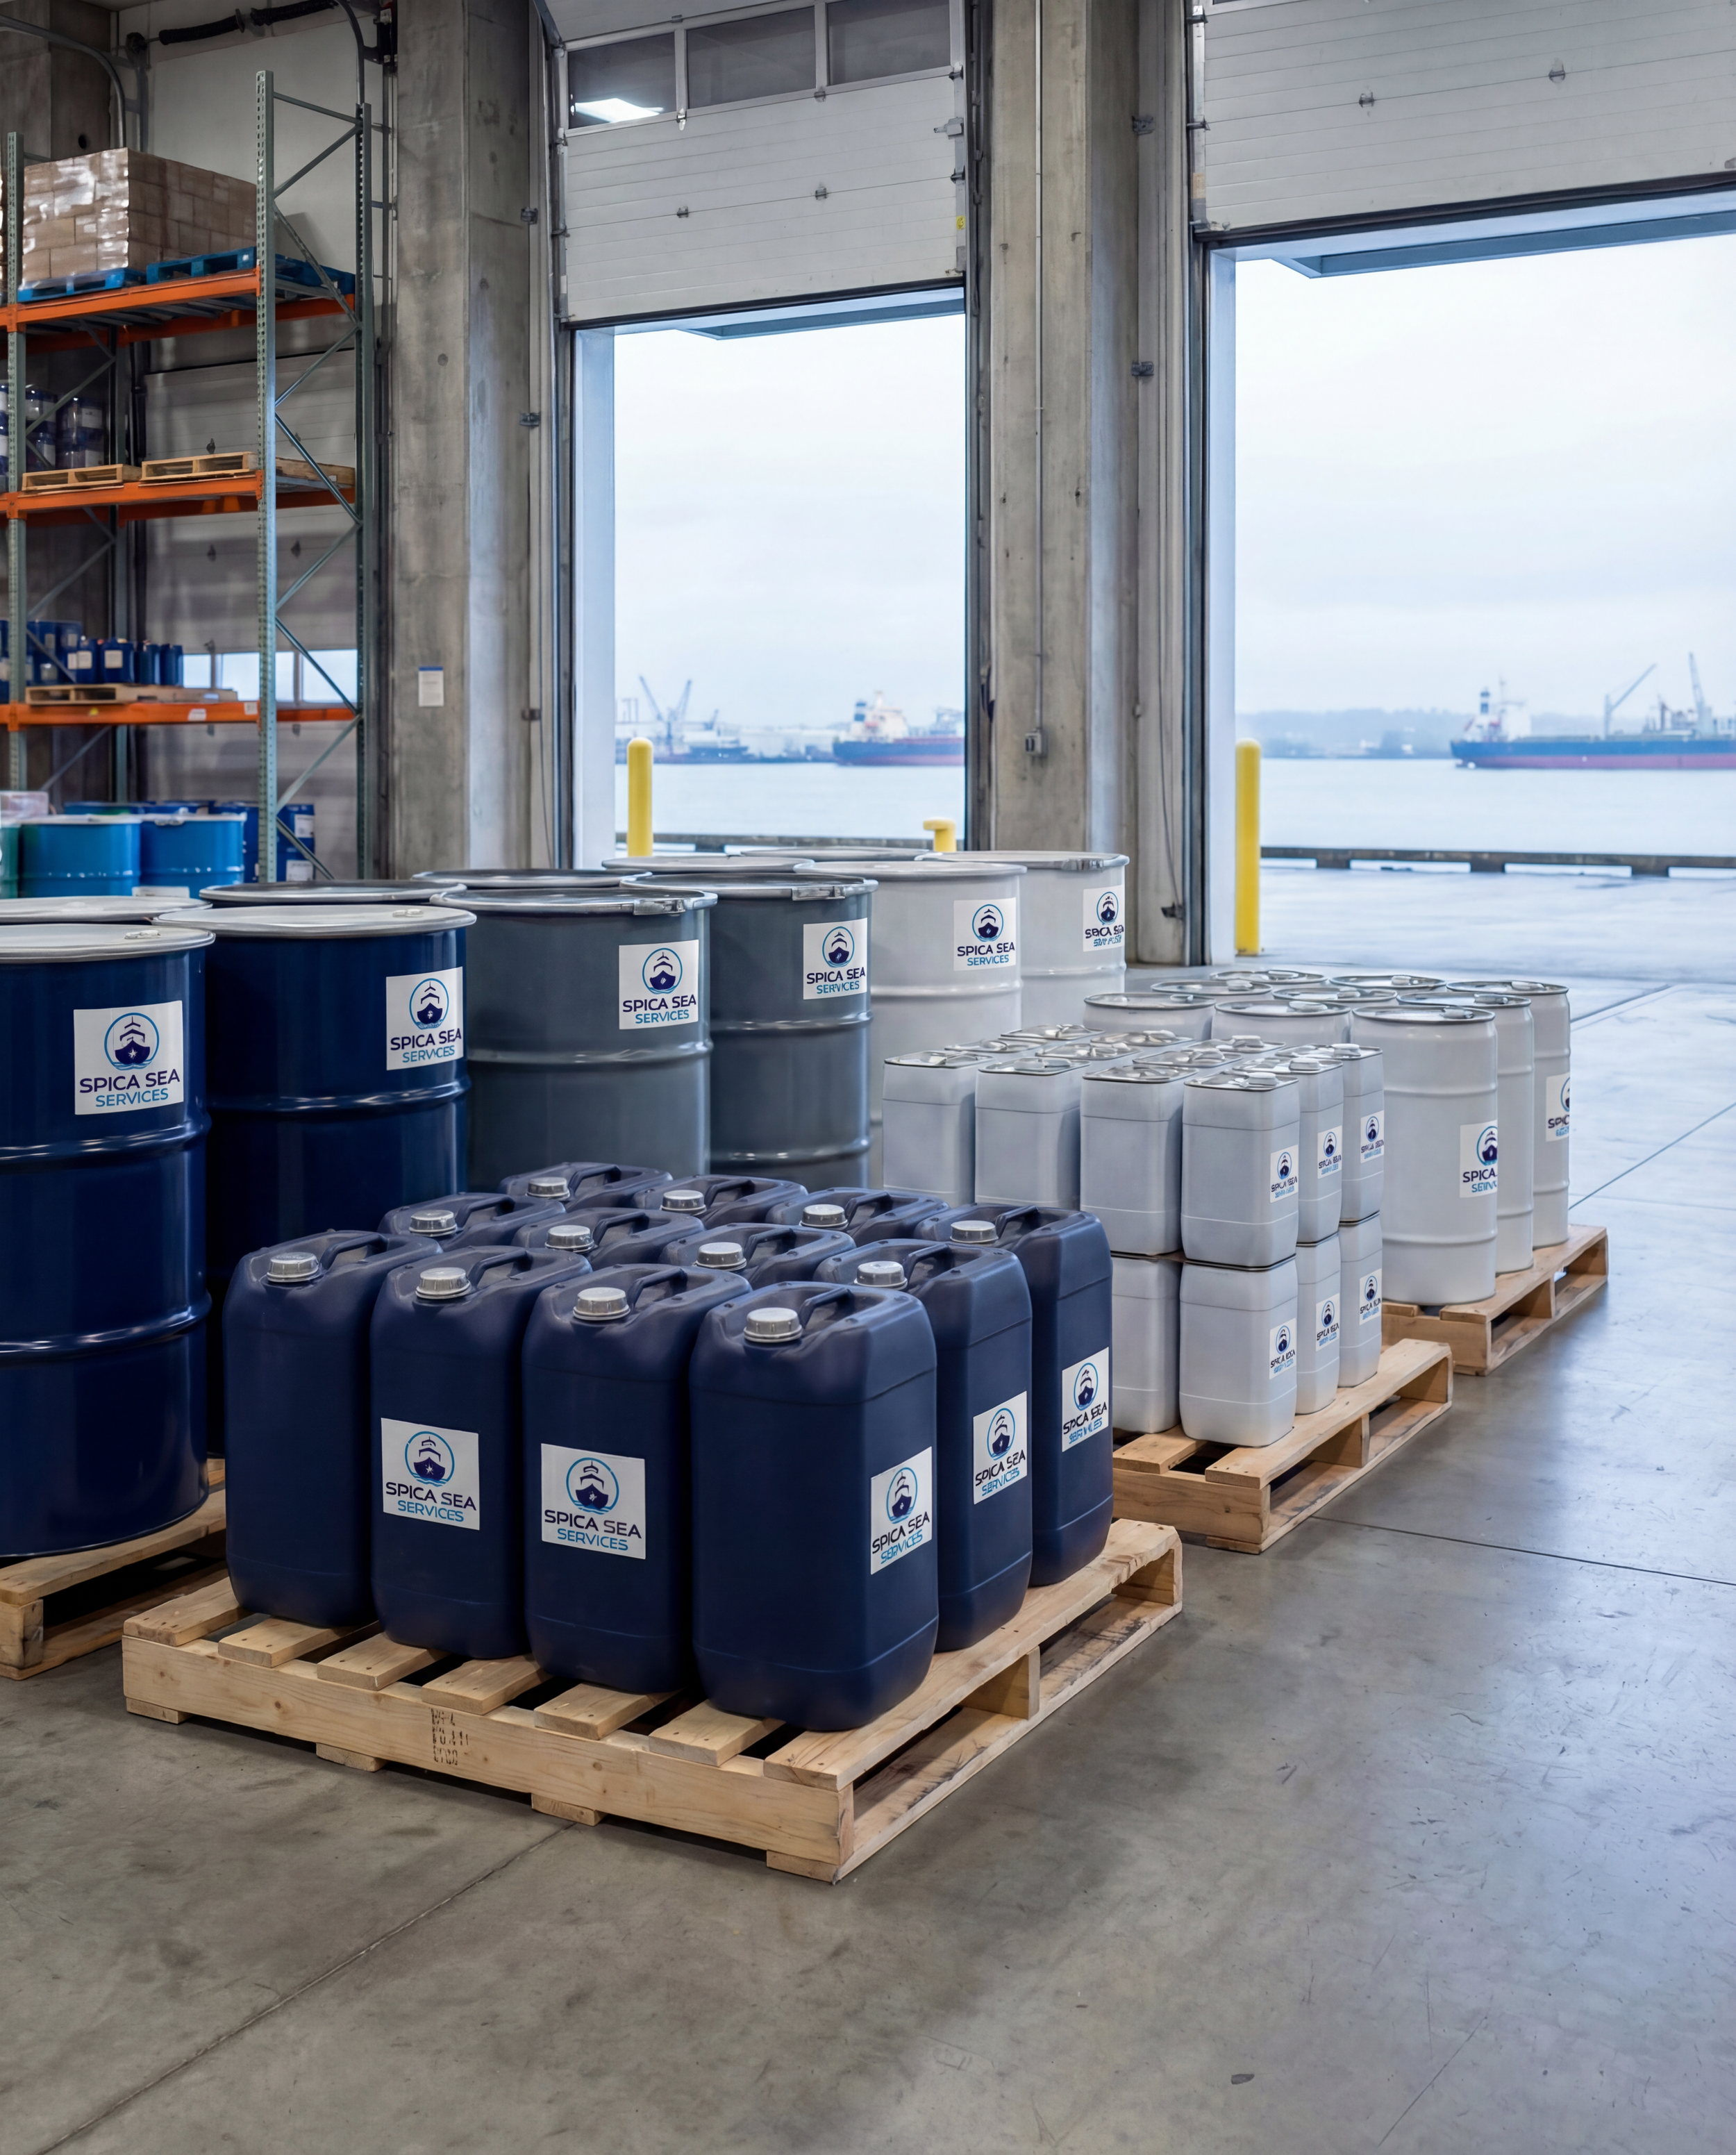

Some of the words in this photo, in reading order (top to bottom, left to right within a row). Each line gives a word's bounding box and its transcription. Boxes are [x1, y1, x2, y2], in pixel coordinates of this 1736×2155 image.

[957, 945, 993, 956] SPICA
[996, 942, 1015, 954] SEA
[967, 954, 1009, 966] SERVICES
[806, 970, 844, 984] SPICA
[846, 967, 866, 980] SEA
[817, 981, 860, 995] SERVICES
[623, 998, 669, 1013] SPICA
[672, 994, 696, 1008] SEA
[635, 1009, 690, 1024] SERVICES
[390, 1033, 435, 1050] SPICA
[439, 1028, 462, 1044] SEA
[402, 1045, 455, 1063] SERVICES
[80, 1074, 140, 1093] SPICA
[145, 1069, 180, 1087] SEA
[95, 1088, 169, 1107] SERVICES
[1462, 1167, 1496, 1183] SPICA
[975, 1461, 1005, 1486] SPICA
[1006, 1449, 1026, 1470] SEA
[982, 1467, 1020, 1497] SERVICES
[385, 1481, 437, 1504] SPICA
[441, 1492, 477, 1511] SEA
[397, 1500, 464, 1522] SERVICES
[544, 1509, 599, 1531] SPICA
[603, 1520, 642, 1539] SEA
[872, 1525, 906, 1554] SPICA
[908, 1511, 930, 1534] SEA
[557, 1528, 628, 1551] SERVICES
[880, 1529, 923, 1565] SERVICES
